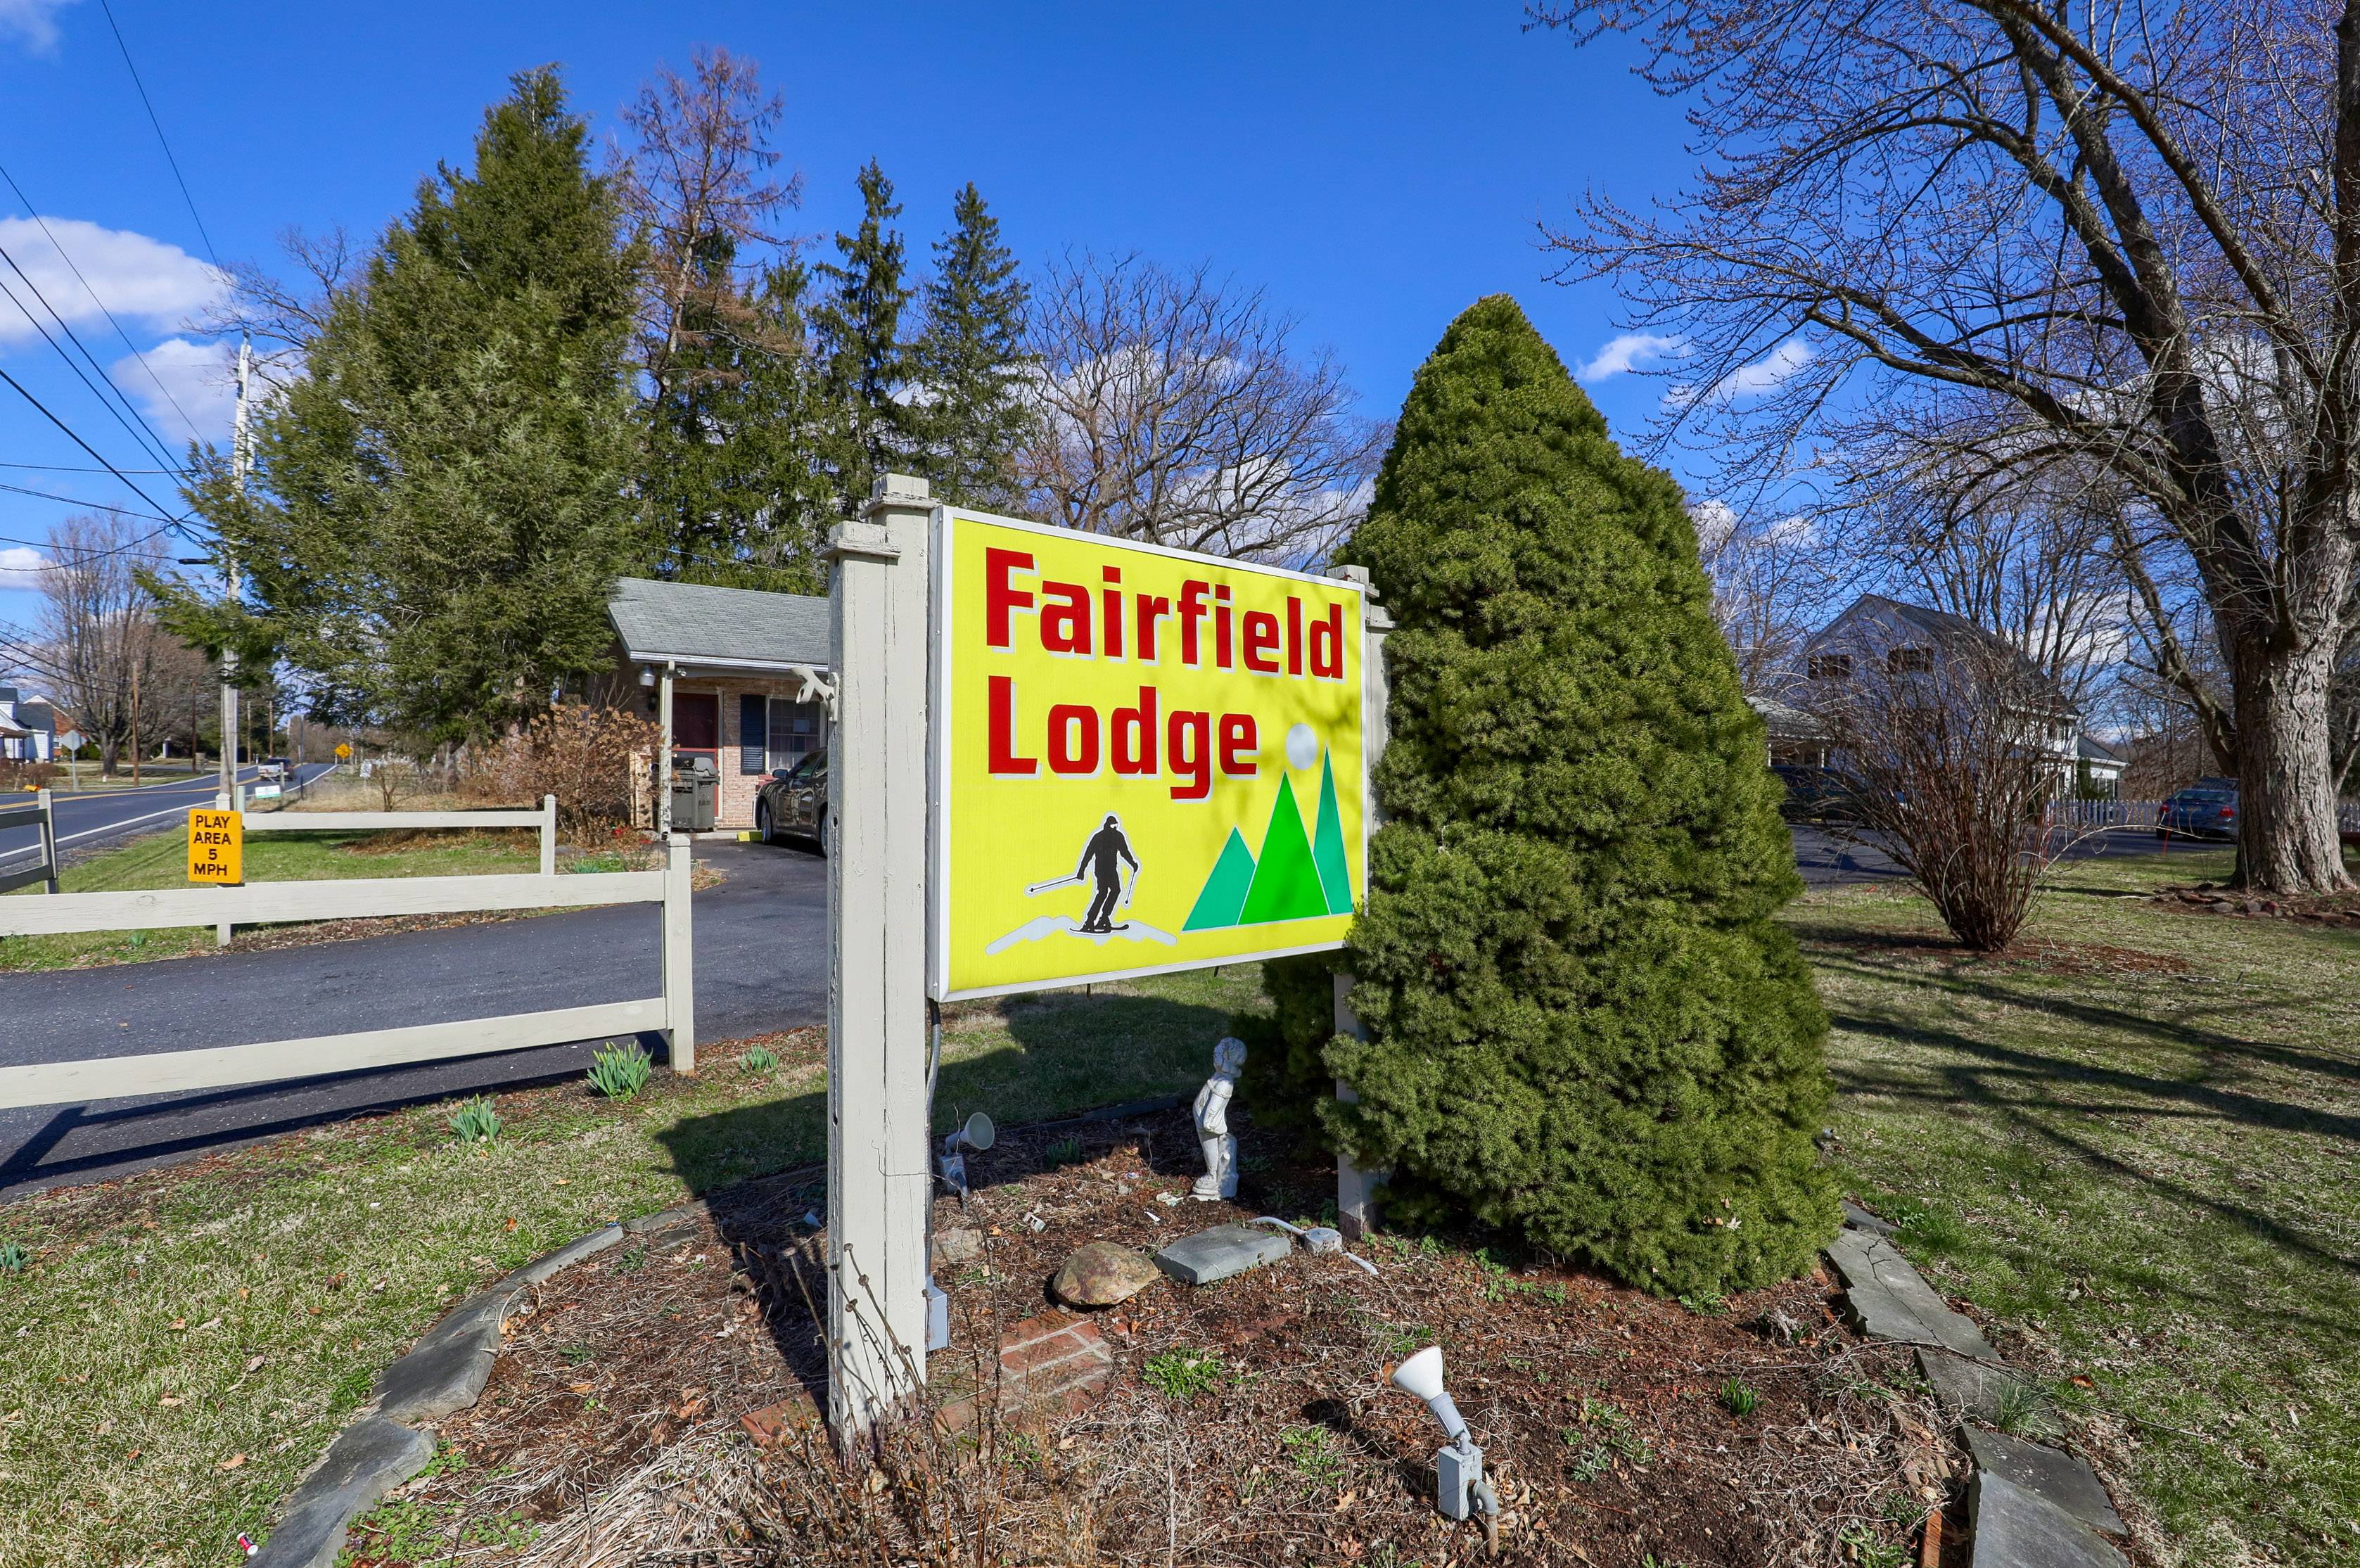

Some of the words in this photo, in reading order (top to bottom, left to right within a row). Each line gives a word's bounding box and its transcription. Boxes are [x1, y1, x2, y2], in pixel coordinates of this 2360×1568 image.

[986, 547, 1346, 682] Fairfield
[988, 675, 1258, 802] Lodge
[196, 815, 231, 829] PLAY
[193, 831, 231, 845] AREA
[208, 848, 217, 860] 5
[193, 863, 227, 876] MPH
